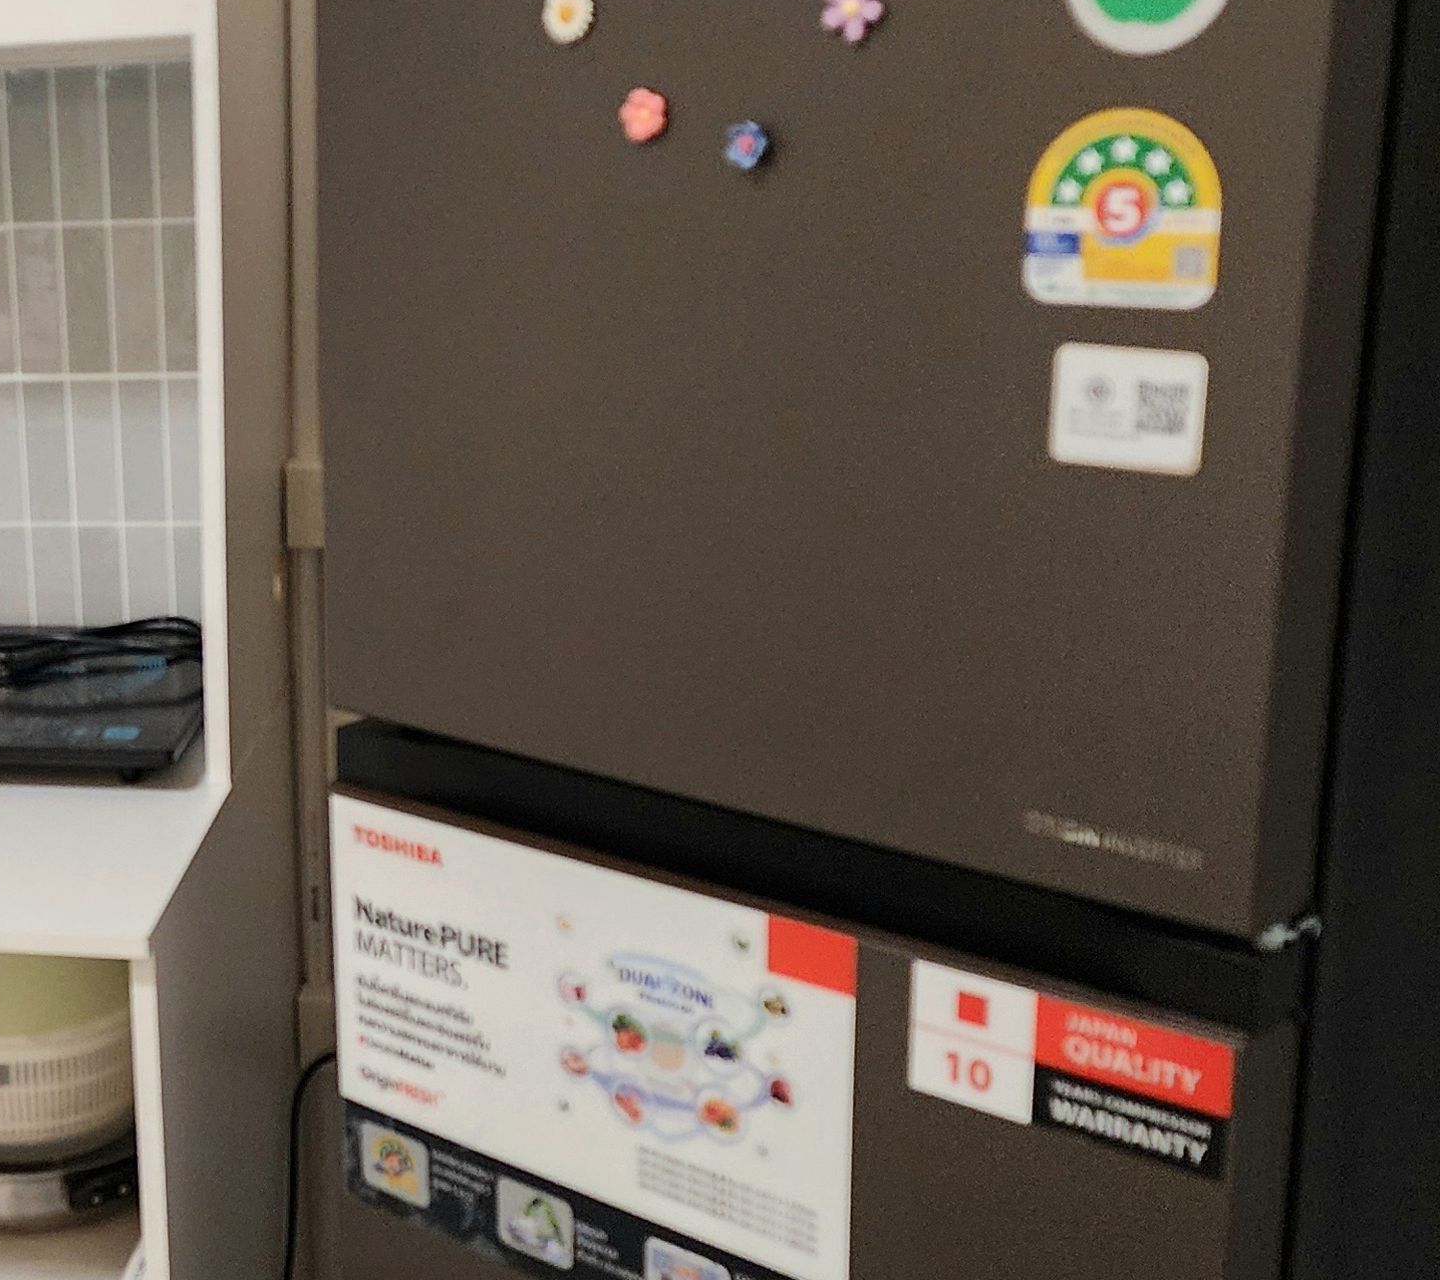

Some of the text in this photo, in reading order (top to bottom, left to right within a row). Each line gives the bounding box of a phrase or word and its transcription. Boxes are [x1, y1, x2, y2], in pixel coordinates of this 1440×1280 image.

[1106, 185, 1143, 234] 5
[353, 824, 444, 868] TOSHIBA
[946, 1051, 993, 1092] 10
[1064, 1035, 1203, 1095] QUALITY
